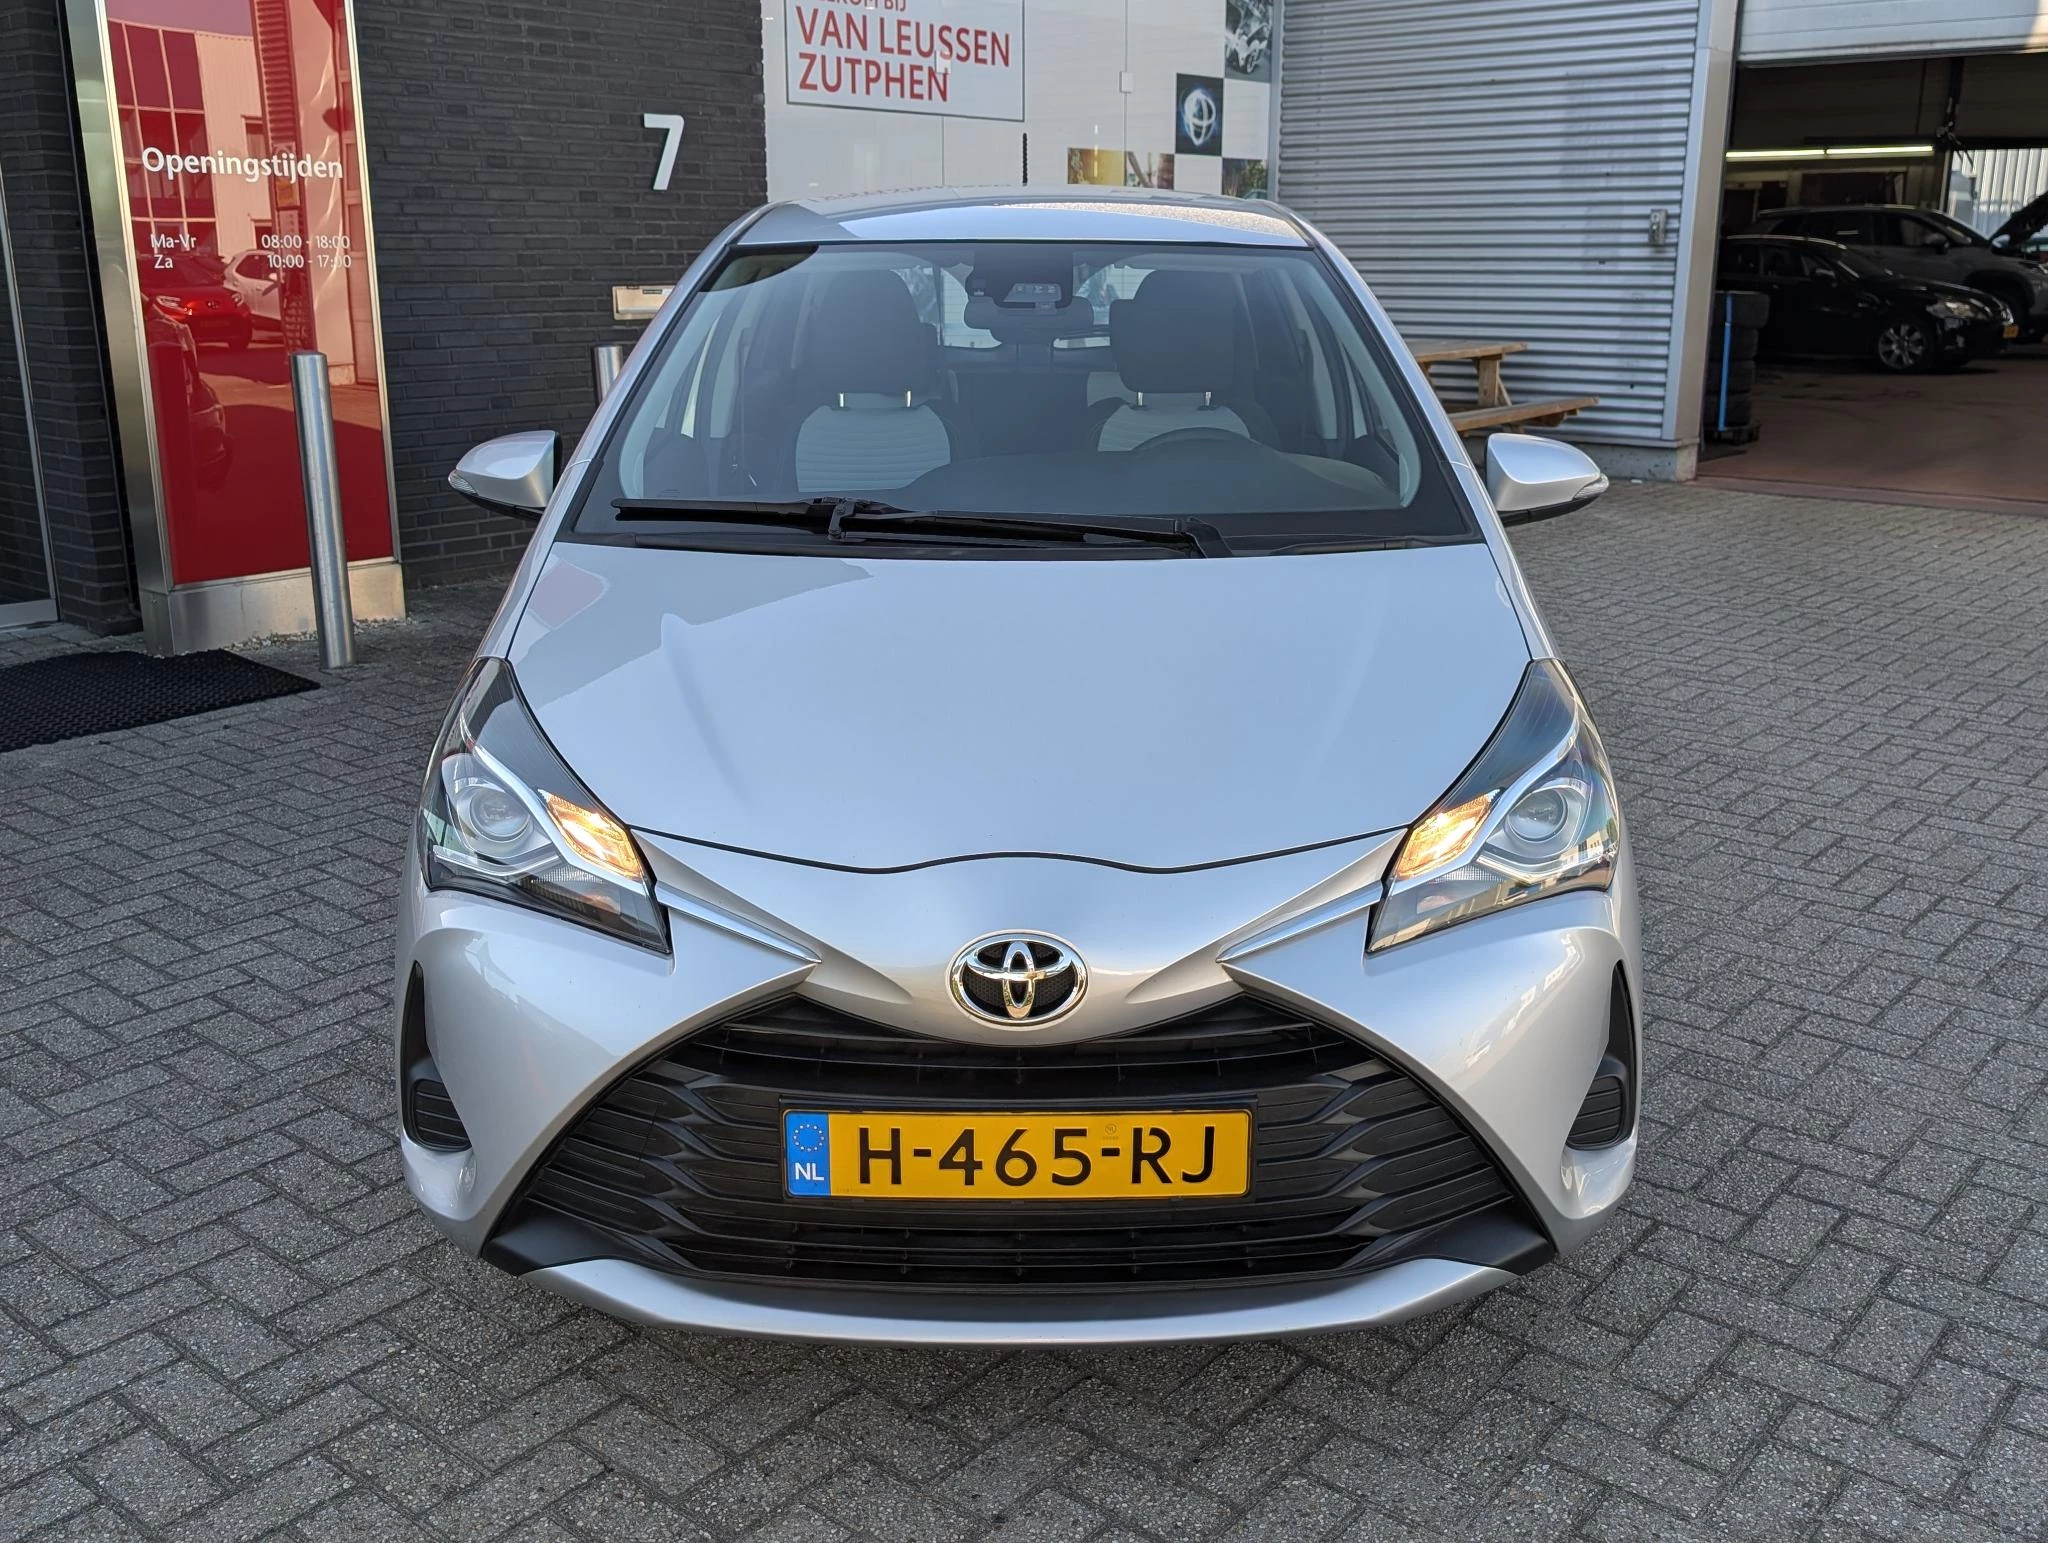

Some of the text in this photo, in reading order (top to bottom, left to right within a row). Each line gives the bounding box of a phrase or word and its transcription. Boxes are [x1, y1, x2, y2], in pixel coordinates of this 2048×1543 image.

[796, 6, 1010, 68] VAN LEUSSEN
[798, 52, 948, 103] ZUTPHEN
[141, 146, 344, 184] Openingstijden
[643, 113, 685, 191] 7
[150, 233, 197, 249] Ma-Vr
[261, 234, 302, 249] 08:00
[316, 235, 350, 249] 18:00
[154, 254, 174, 269] Za
[267, 254, 305, 268] 10:00
[317, 254, 352, 268] 17:00
[795, 1162, 825, 1181] NL
[858, 1125, 1217, 1187] H-465-RJ
